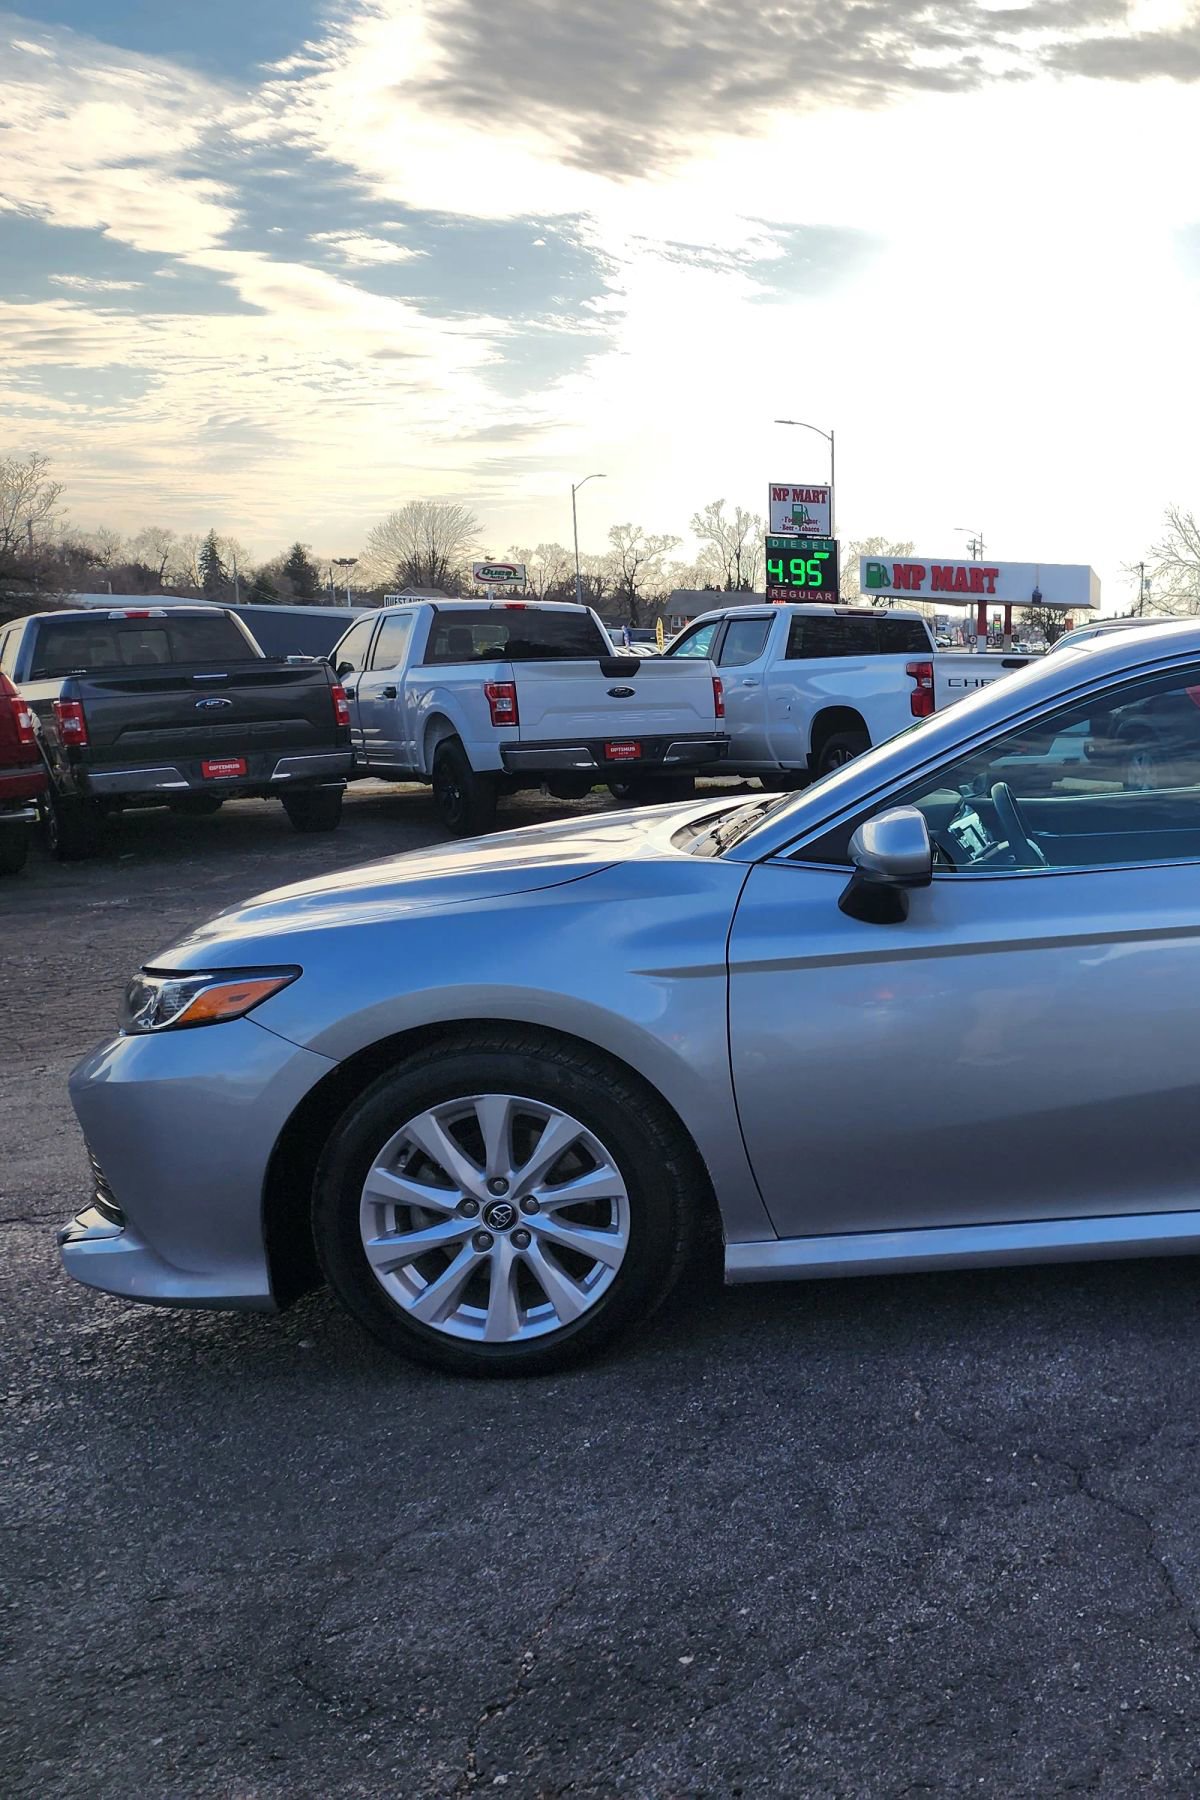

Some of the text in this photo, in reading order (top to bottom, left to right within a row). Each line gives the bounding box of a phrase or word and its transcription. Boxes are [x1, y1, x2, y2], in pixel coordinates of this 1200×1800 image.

[772, 487, 828, 504] NP MART
[772, 539, 829, 550] DIESEL
[482, 568, 518, 577] Quest
[892, 564, 999, 594] NP MART
[771, 588, 832, 600] REGULAR
